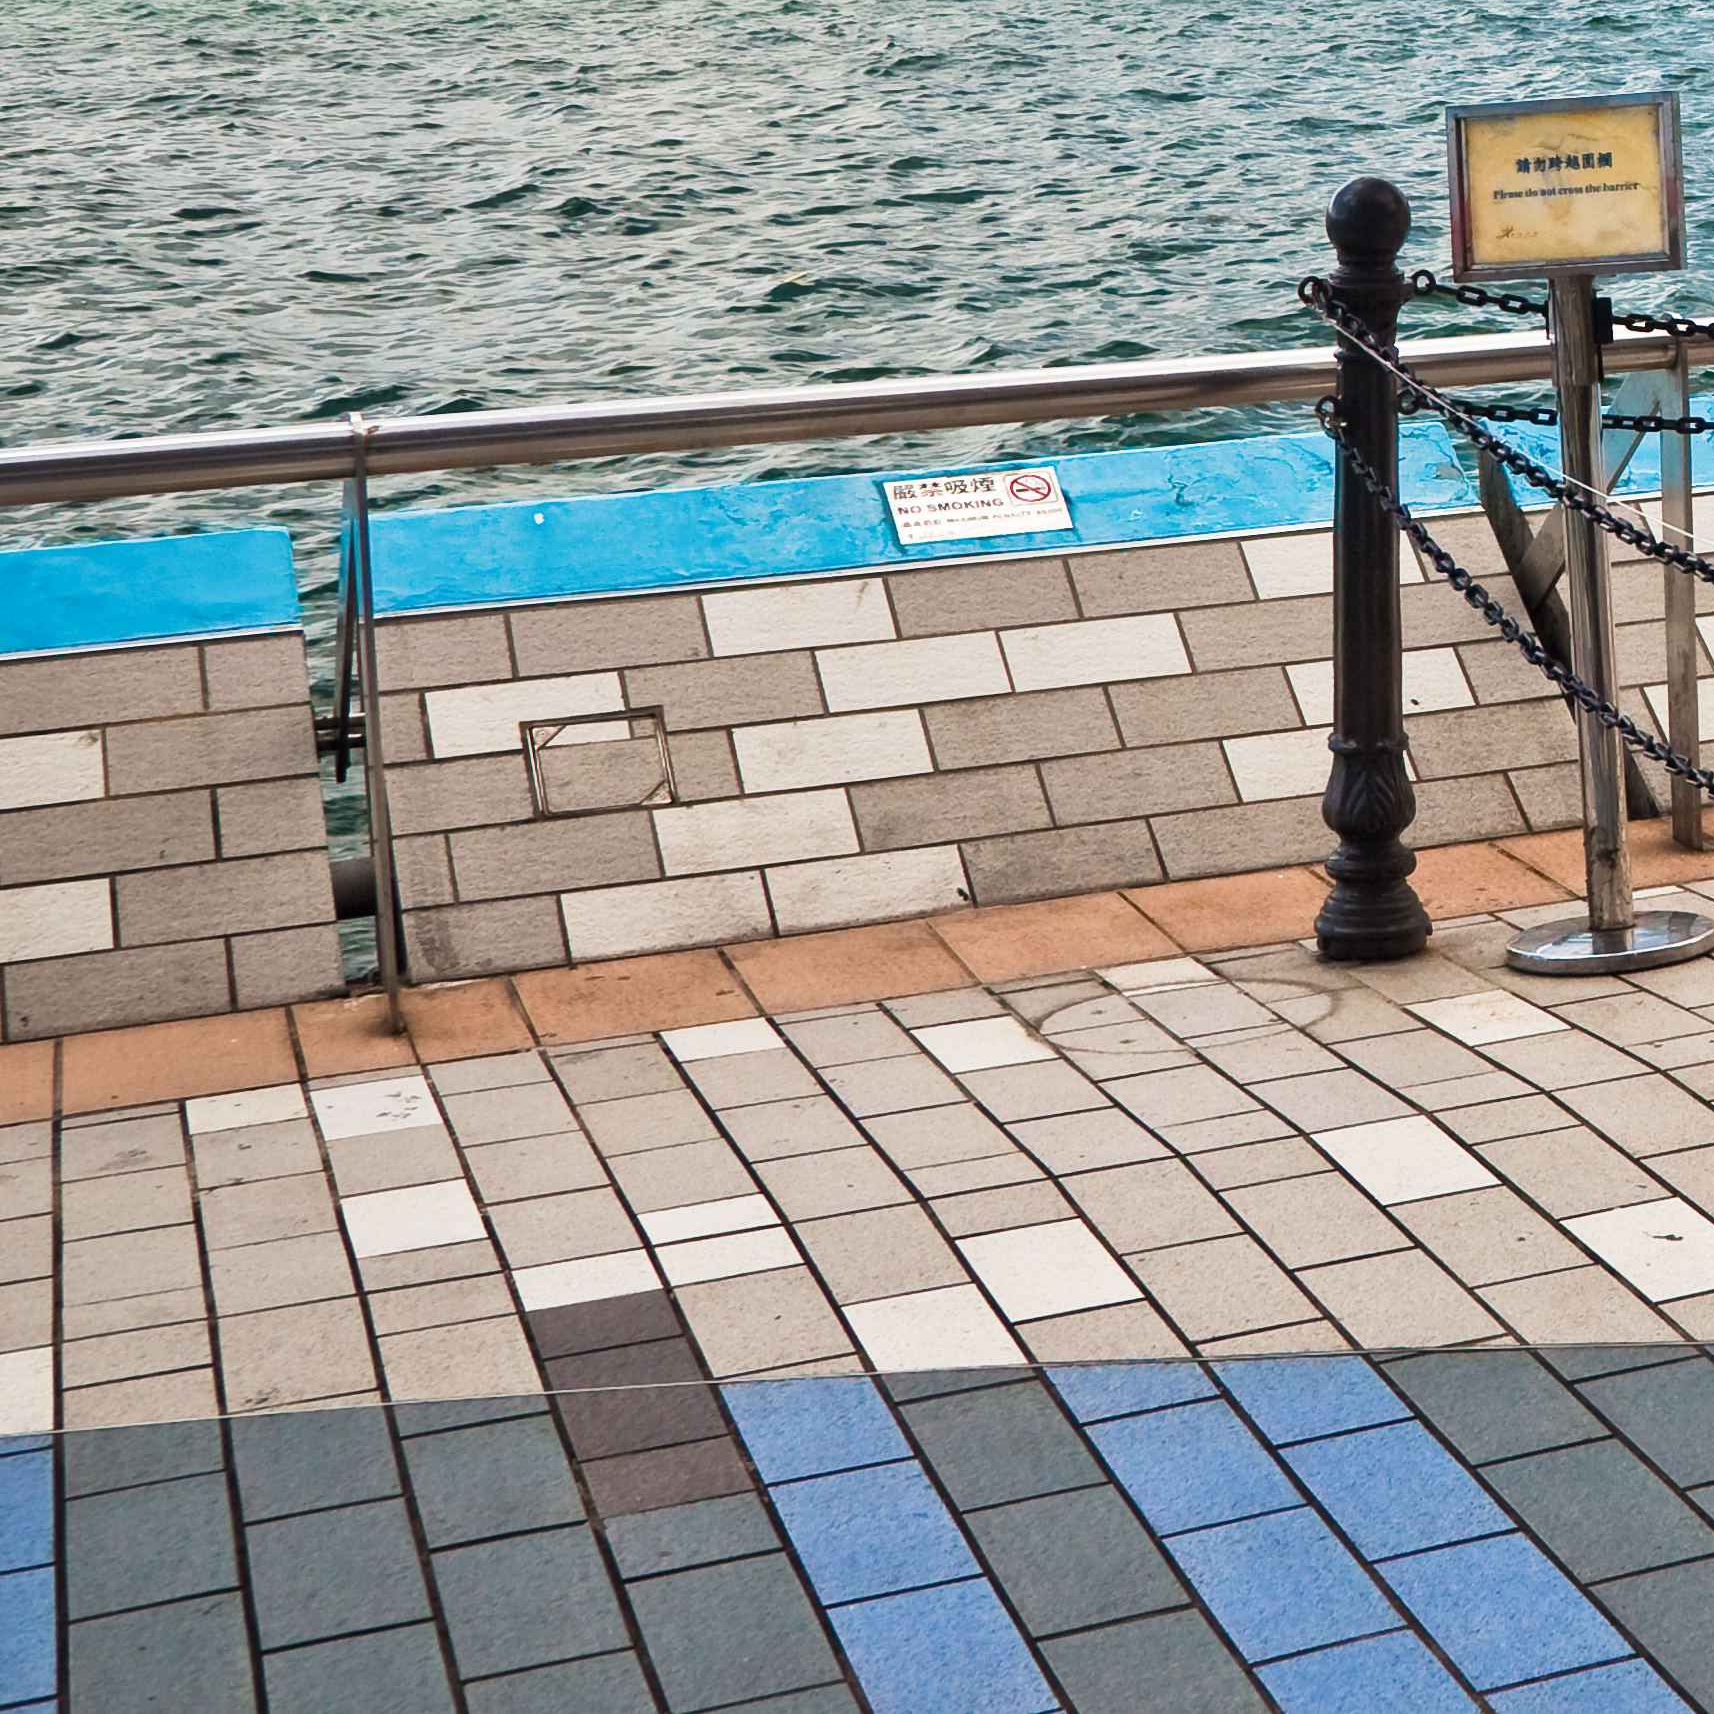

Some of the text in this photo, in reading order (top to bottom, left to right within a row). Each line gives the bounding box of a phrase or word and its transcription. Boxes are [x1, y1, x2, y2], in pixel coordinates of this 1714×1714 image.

[1493, 181, 1639, 200] Please do not cross the barrier
[898, 498, 1004, 515] NO SMOKING
